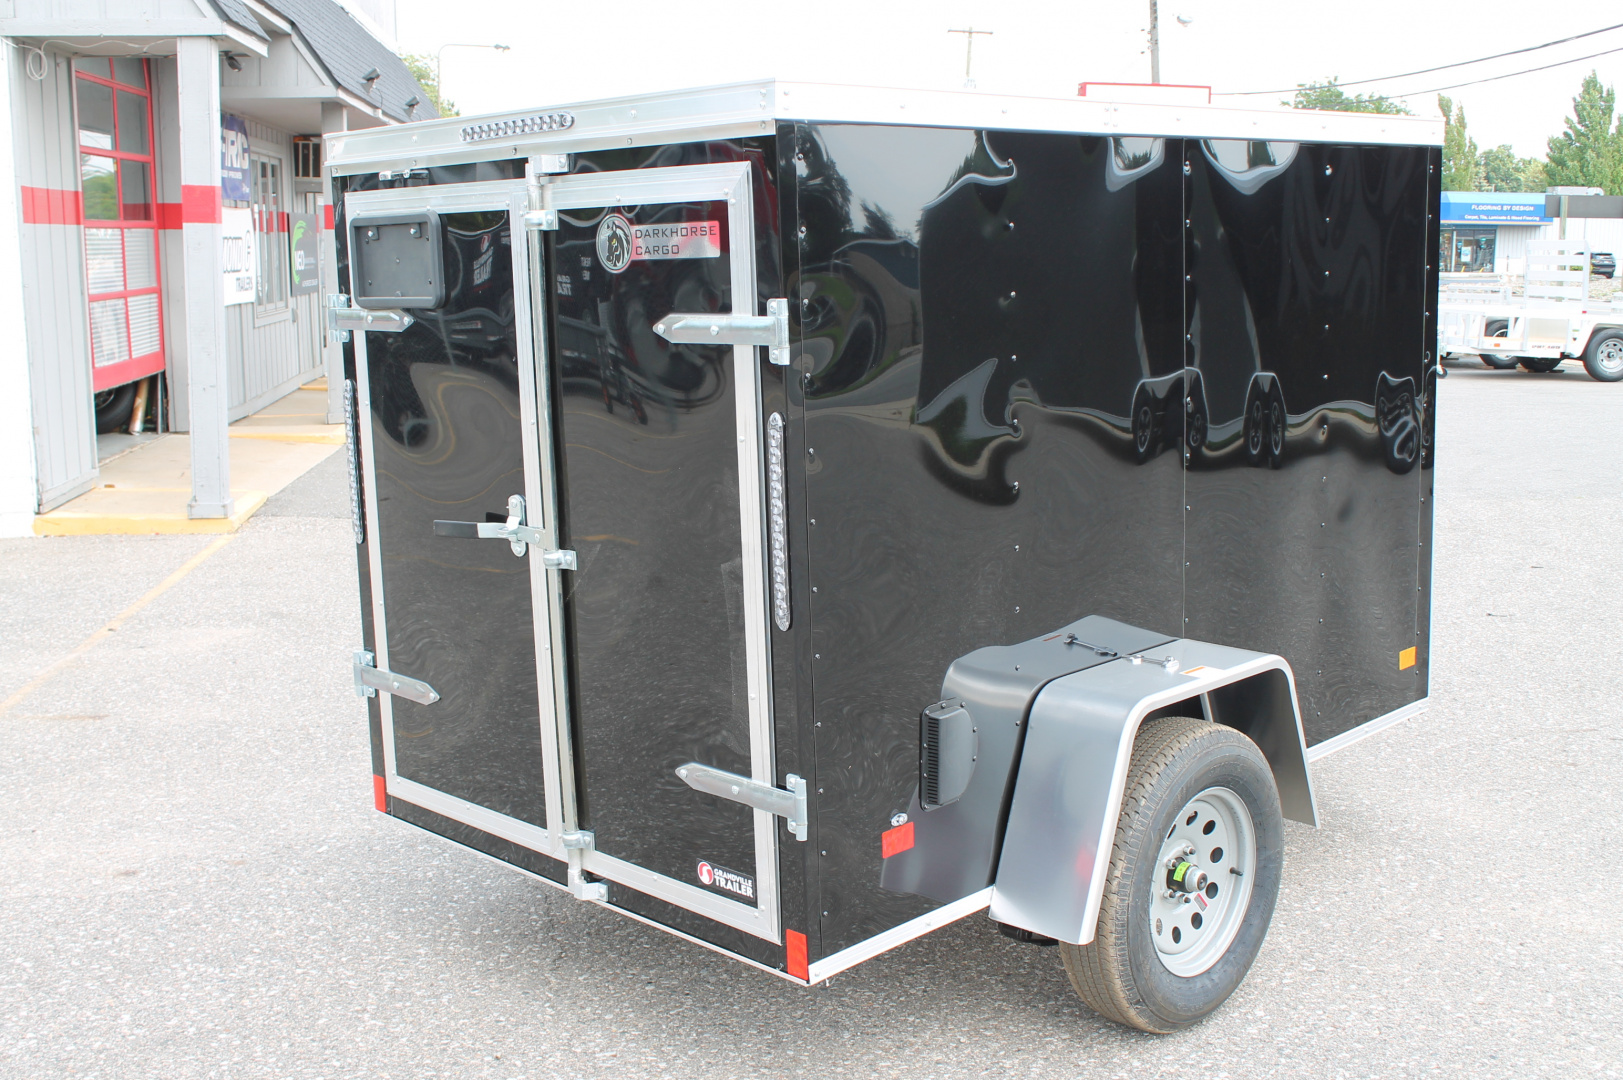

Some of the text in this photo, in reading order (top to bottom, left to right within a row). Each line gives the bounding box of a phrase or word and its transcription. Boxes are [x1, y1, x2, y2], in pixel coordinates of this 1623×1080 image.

[634, 225, 717, 239] DARKHORSE
[635, 244, 680, 256] CARGO
[713, 868, 753, 887] GRANDVILLE
[714, 876, 754, 898] TRAILER
